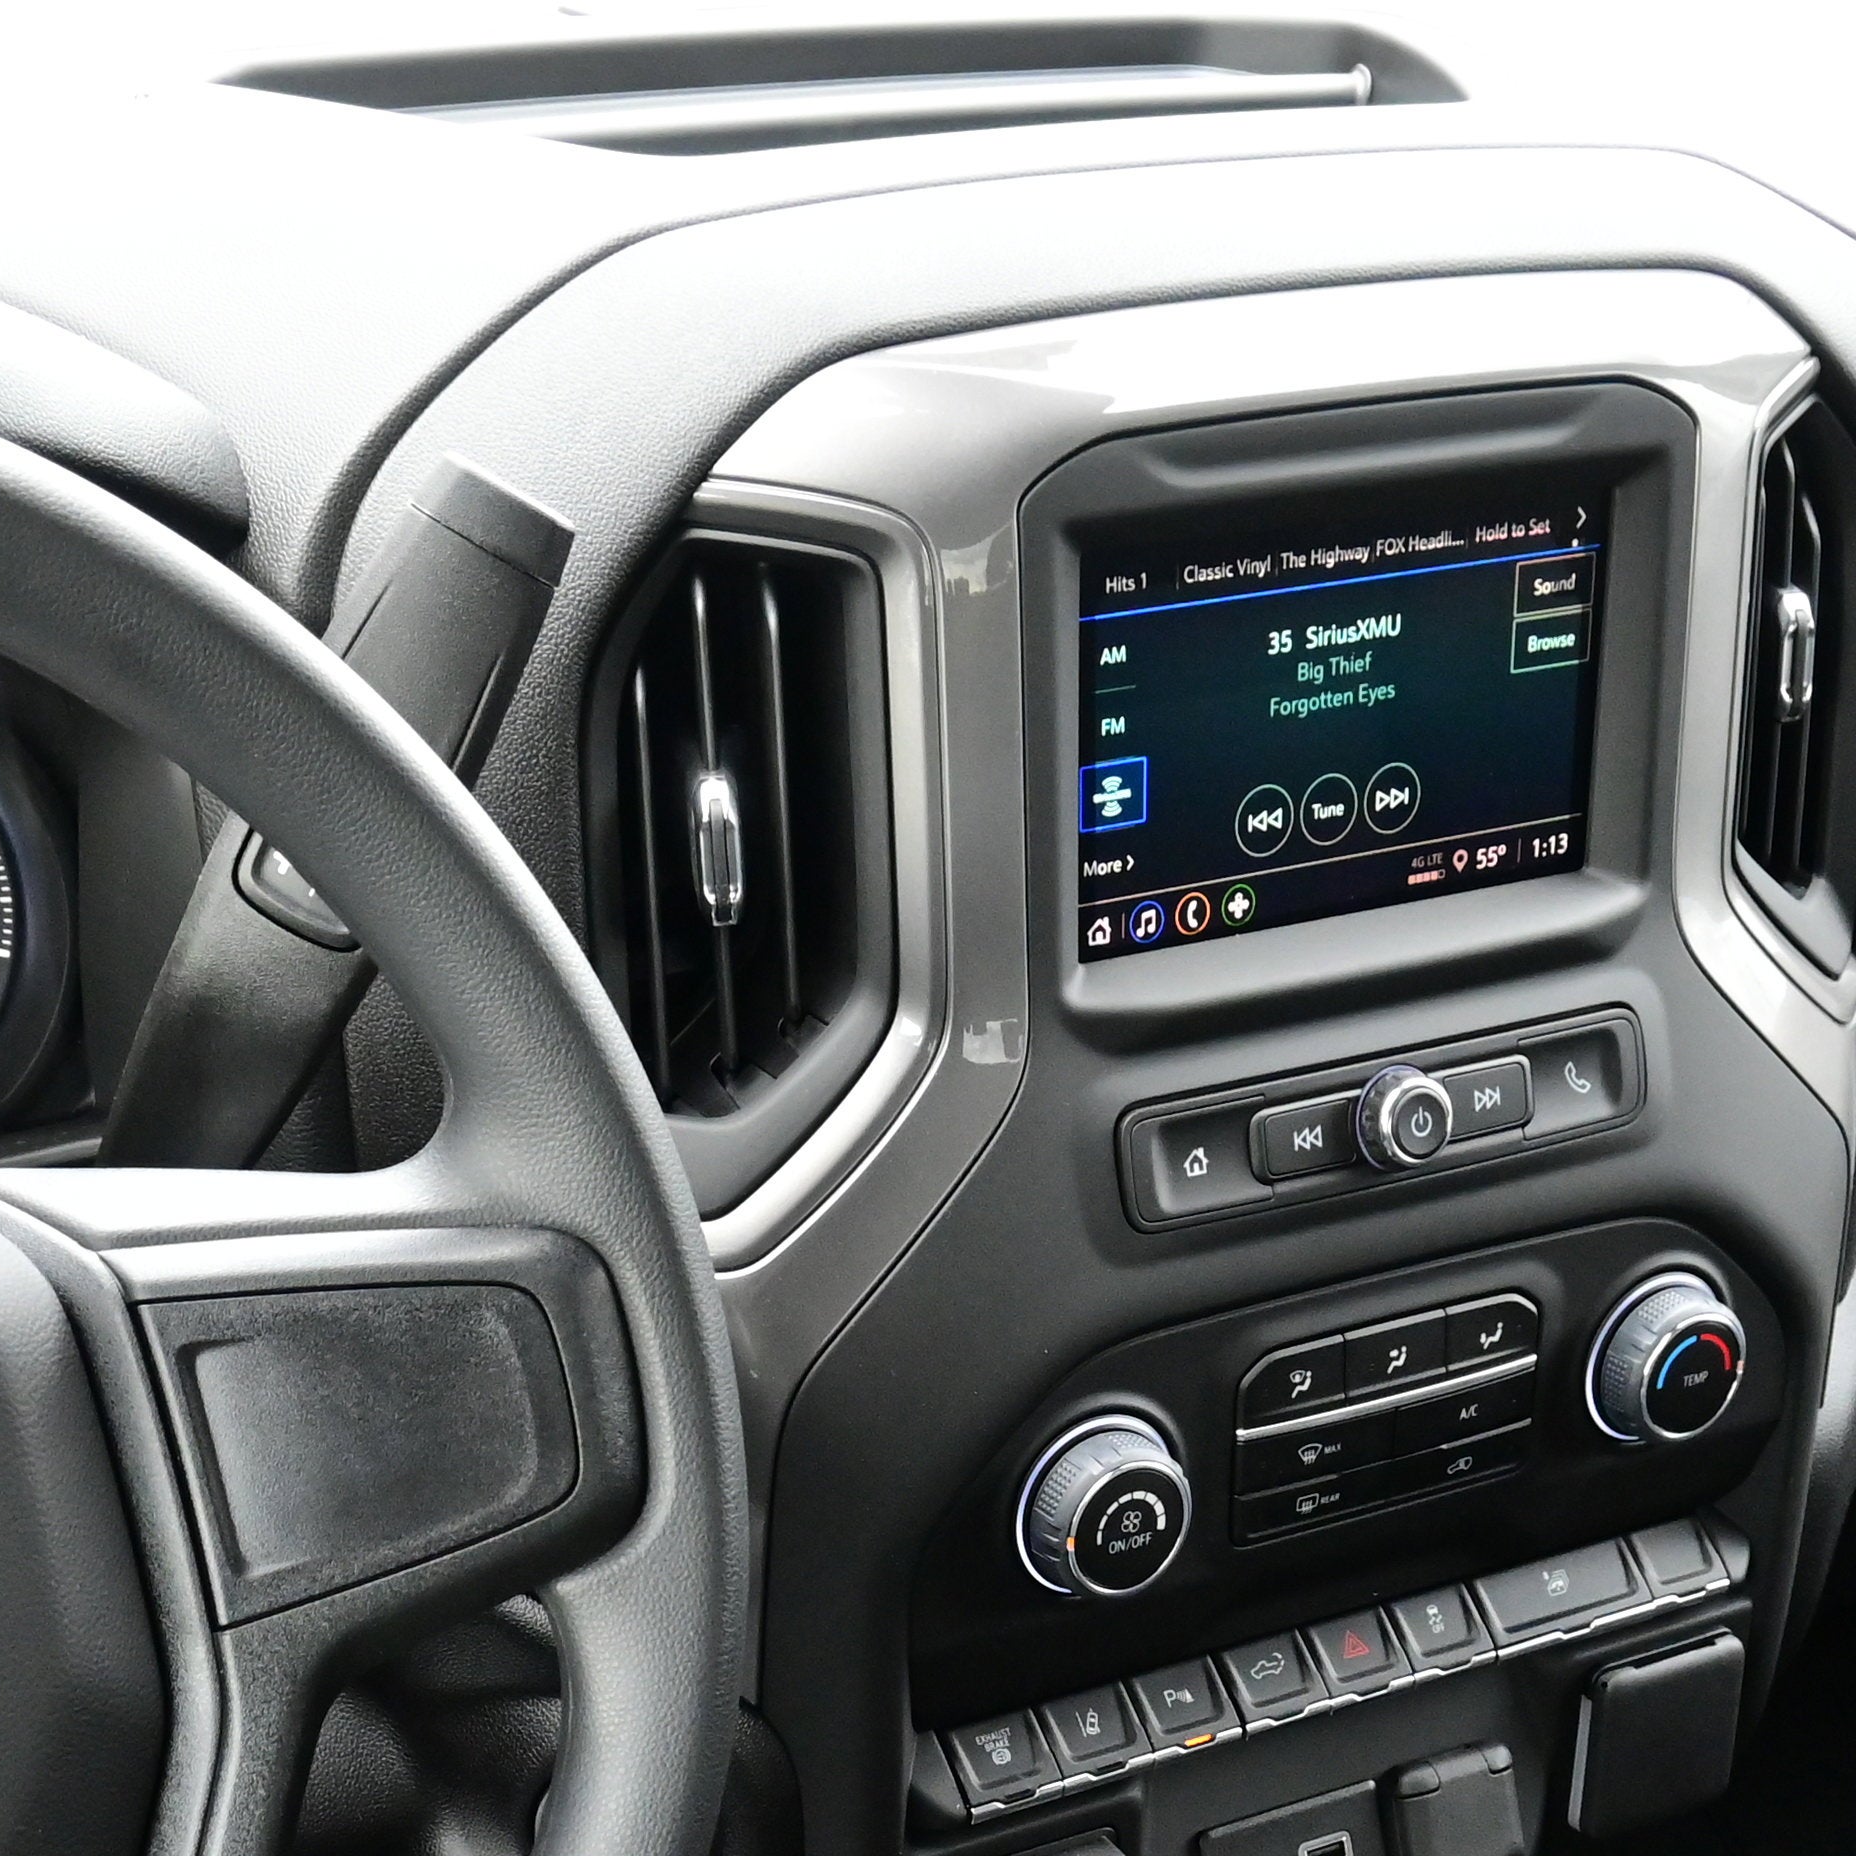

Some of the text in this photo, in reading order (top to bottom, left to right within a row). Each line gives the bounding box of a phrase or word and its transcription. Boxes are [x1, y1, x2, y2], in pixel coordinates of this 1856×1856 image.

[1475, 518, 1551, 543] Hold to Set
[1376, 536, 1406, 557] FOX
[1280, 545, 1371, 571] The Highway
[1183, 555, 1272, 584] Classic Vinyl
[1105, 572, 1148, 594] Hits 1
[1533, 573, 1576, 596] Sound
[1267, 613, 1402, 656] 35 SiriusXMU
[1527, 632, 1576, 653] Browse
[1099, 645, 1126, 666] AM
[1297, 651, 1373, 685] Big Thief
[1270, 683, 1396, 719] Forgotten Eyes
[1101, 717, 1126, 737] FM
[1312, 800, 1345, 821] Tune
[1532, 832, 1569, 858] 1:13
[1084, 859, 1123, 877] More
[1410, 852, 1444, 869] 4G LTE
[1682, 1370, 1709, 1388] TEMP
[1459, 1402, 1479, 1421] A/C
[1108, 1530, 1153, 1555] ON/OFF
[975, 1727, 1012, 1746] EXHAUST
[984, 1737, 1011, 1753] BRAKE
